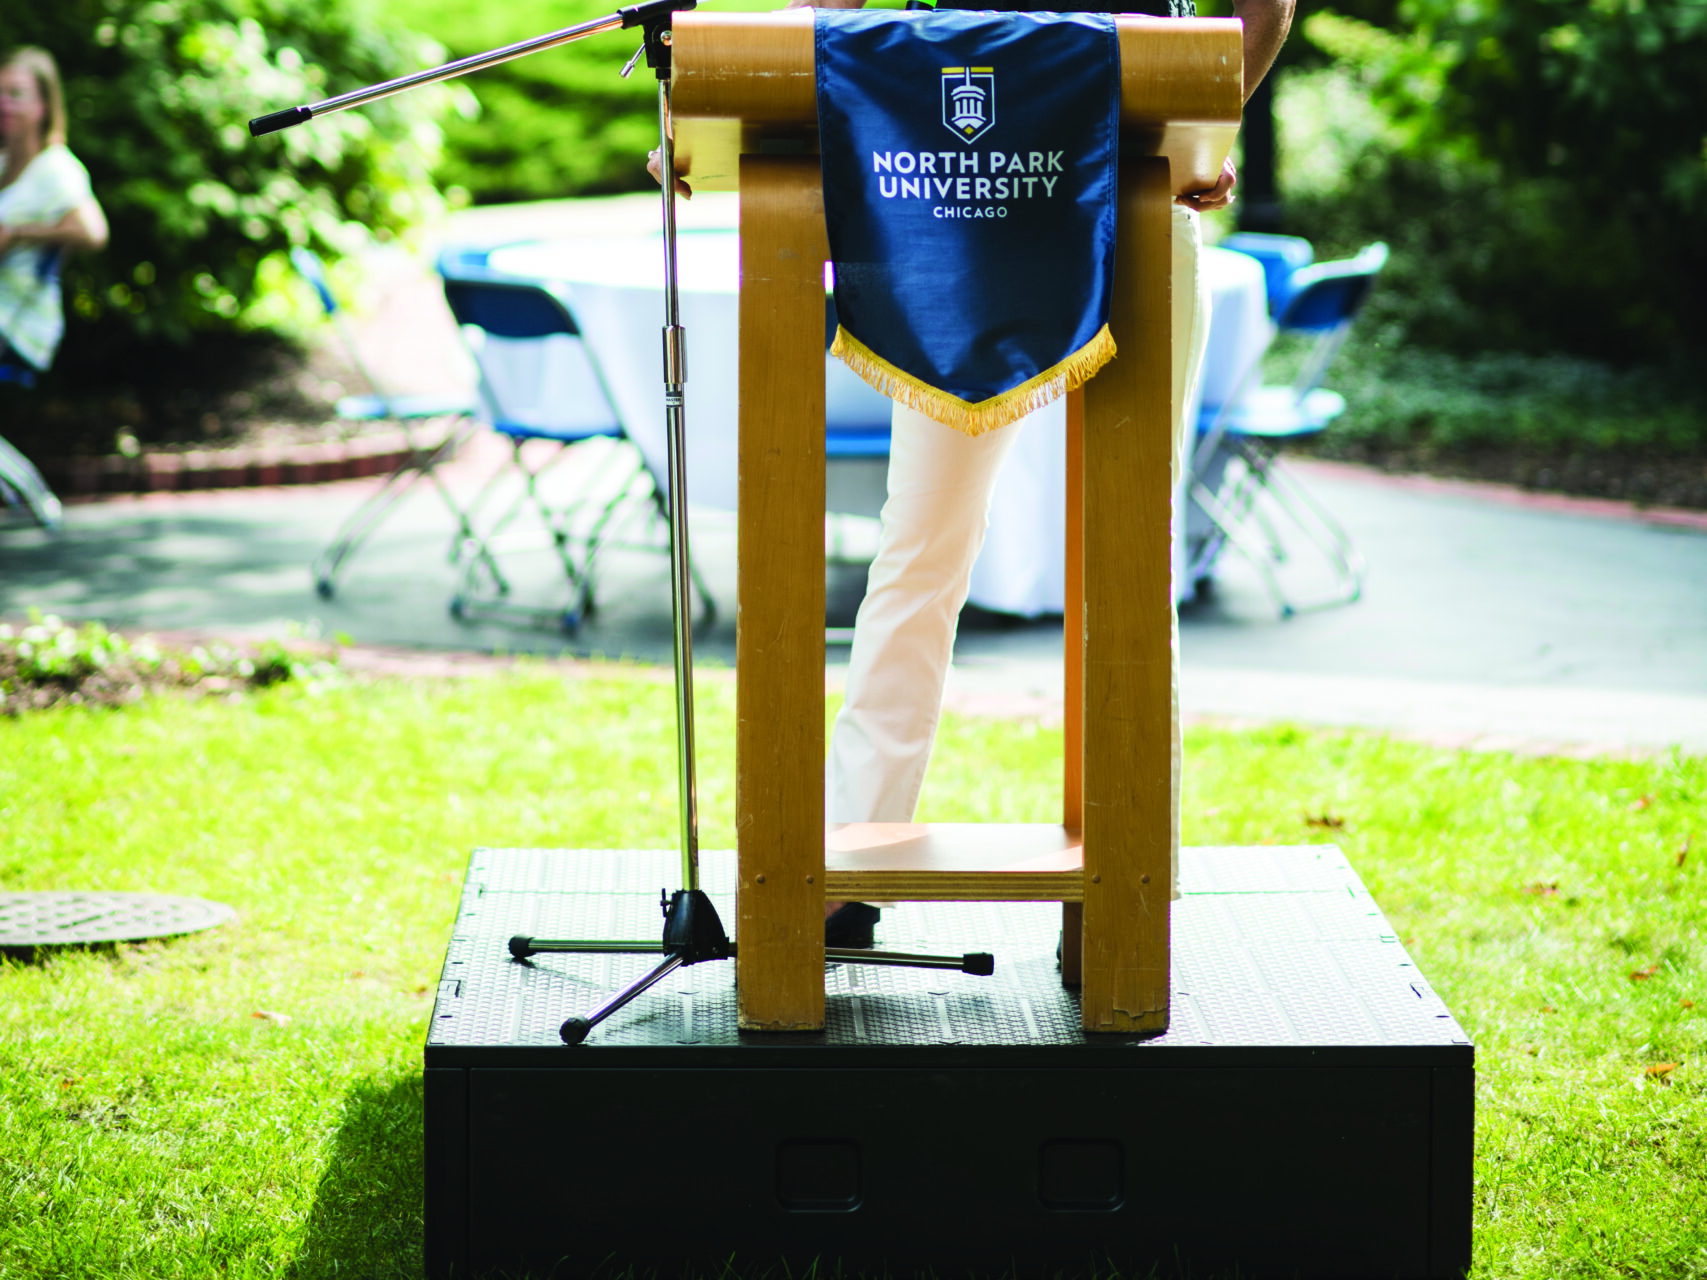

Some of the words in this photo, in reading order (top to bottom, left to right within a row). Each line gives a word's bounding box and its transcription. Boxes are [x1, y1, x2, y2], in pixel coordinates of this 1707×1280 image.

[872, 150, 979, 174] NORTH
[990, 150, 1065, 174] PARK
[878, 175, 1059, 200] UNIVERSITY
[932, 206, 1008, 219] CHICAGO
